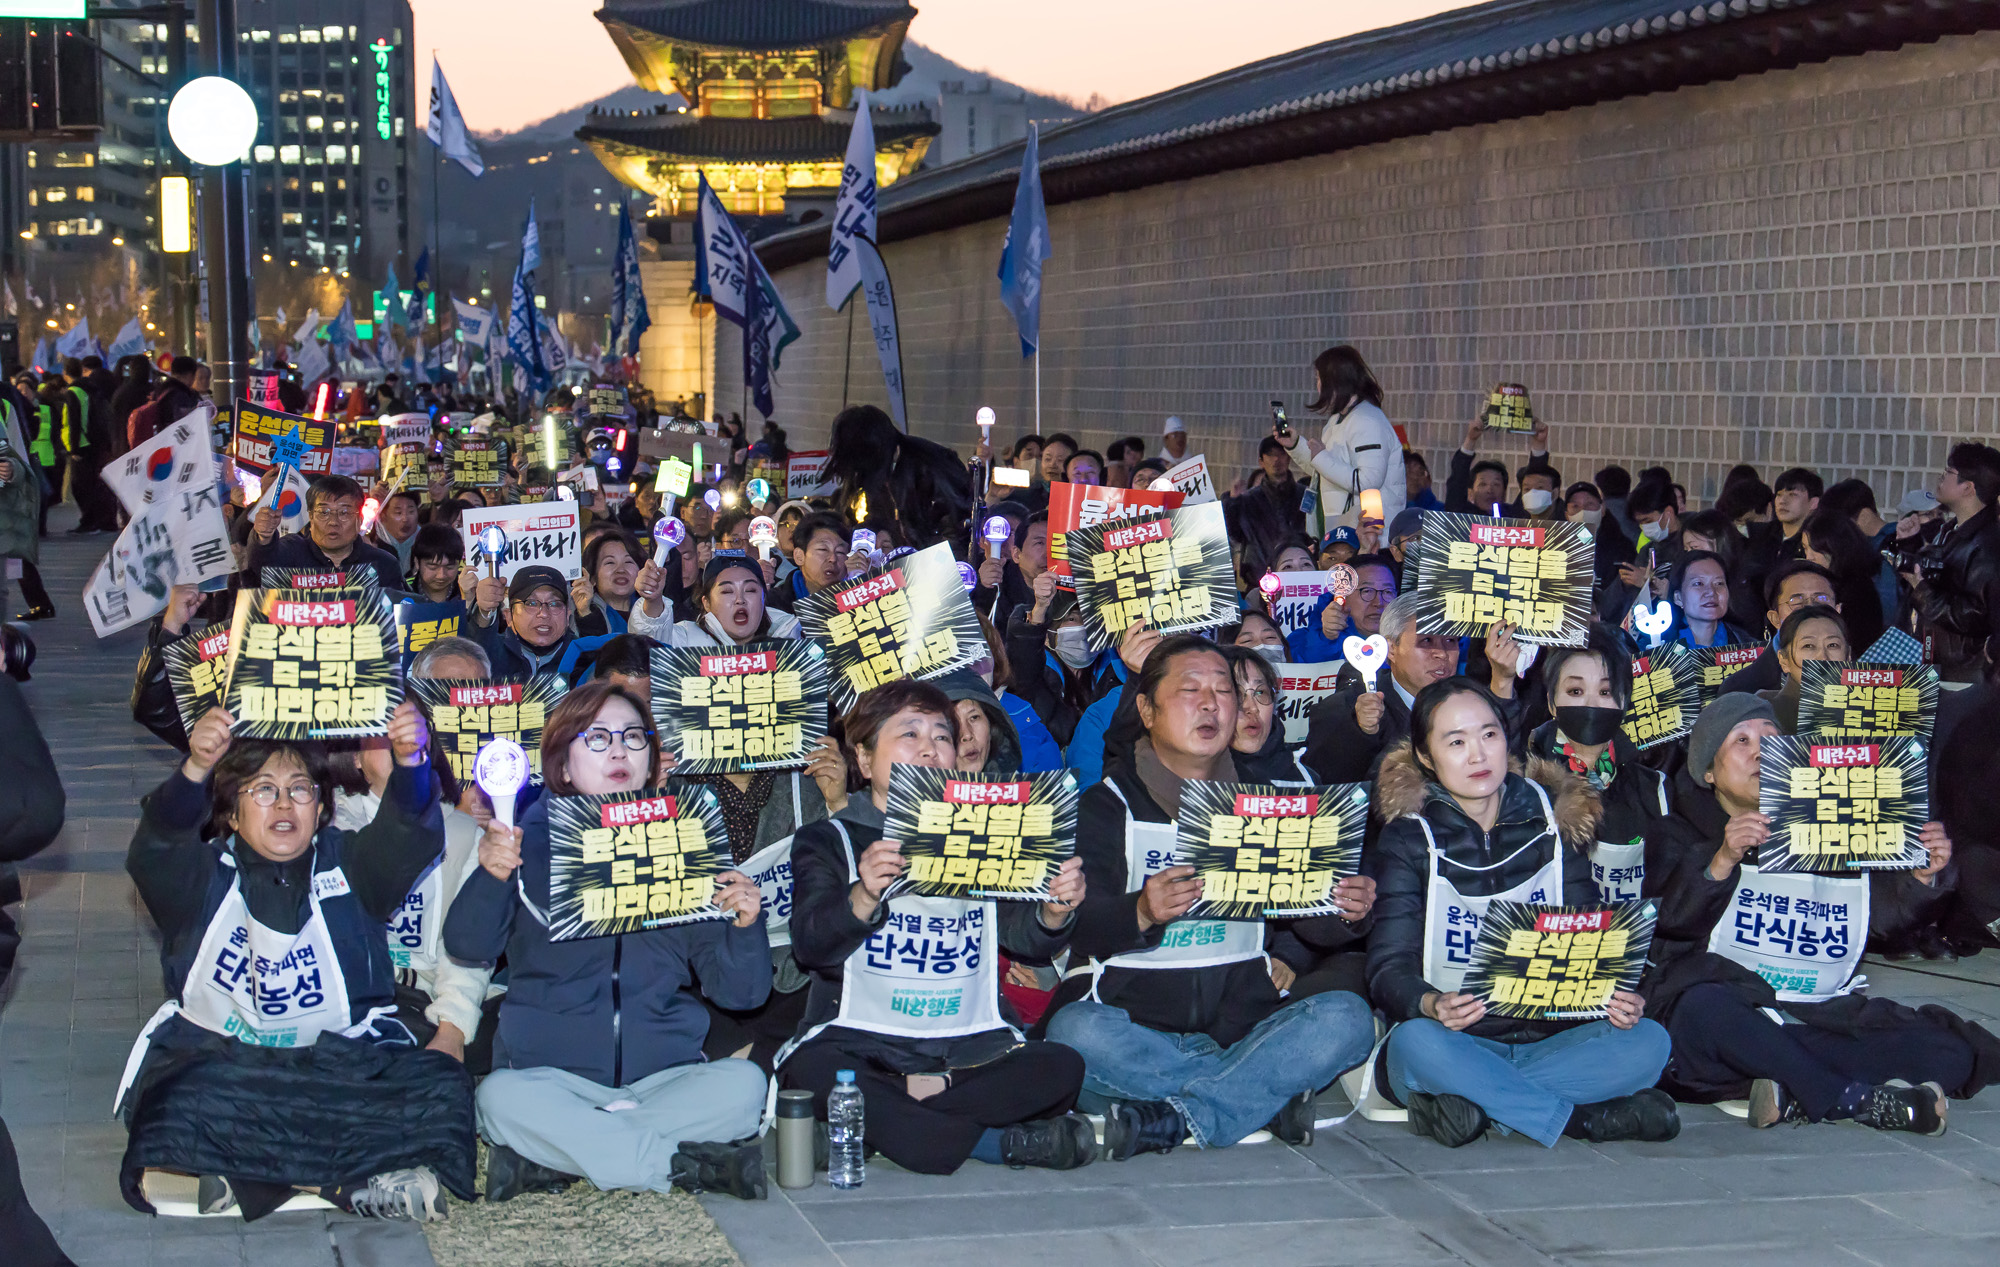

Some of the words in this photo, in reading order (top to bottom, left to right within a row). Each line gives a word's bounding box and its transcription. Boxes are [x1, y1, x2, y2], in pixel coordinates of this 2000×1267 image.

[239, 410, 325, 446] 윤석열을
[1109, 521, 1163, 546] 내란수괴
[1477, 527, 1535, 544] 내란수괴
[1091, 536, 1203, 583] 윤석열을
[1448, 541, 1568, 580] 윤석열을
[297, 575, 339, 588] 내란수괴
[841, 574, 896, 607] 내란수괴
[1115, 568, 1181, 600] 즉-각!
[1472, 572, 1540, 601] 즉-각!
[277, 602, 346, 624] 내란수괴
[1100, 585, 1212, 633] 파면하라
[1444, 592, 1565, 631] 파면하라
[246, 623, 384, 662] 윤석열을
[1720, 649, 1758, 664] 내란수괴
[272, 660, 356, 687] 즉-각!
[708, 657, 767, 675] 내란수괴
[845, 627, 960, 694] 파면하라
[680, 671, 802, 706] 윤석열을
[1847, 671, 1894, 684] 내란수괴
[239, 686, 388, 723] 파면하라
[457, 686, 513, 704] 내란수괴
[1823, 684, 1920, 712] 윤석열을
[433, 702, 545, 733] 윤석열을
[708, 703, 777, 727] 즉-각!
[1844, 709, 1899, 729] 즉-각!
[682, 723, 803, 760] 파면하라
[1816, 749, 1870, 764] 내란수괴
[953, 784, 1019, 801] 내란수괴
[1790, 767, 1903, 798] 윤석열을
[608, 798, 669, 823] 내란수괴
[917, 801, 1054, 836] 윤석열을
[1242, 797, 1308, 814] 내란수괴
[1816, 799, 1880, 822] 즉-각!
[582, 817, 708, 864] 윤석열을
[1208, 814, 1341, 848] 윤석열을
[1789, 823, 1906, 855] 파면하라
[943, 835, 1023, 859] 즉-각!
[1235, 848, 1311, 871] 즉-각!
[611, 853, 686, 884] 즉-각!
[907, 855, 1047, 887] 파면하라
[582, 876, 715, 922] 파면하라
[1202, 870, 1333, 902] 파면하라
[1737, 888, 1790, 915] 윤석열
[1794, 898, 1848, 922] 즉각파면
[887, 912, 922, 934] 석열
[1543, 914, 1602, 930] 내란수괴
[1734, 910, 1849, 958] 단식농성
[865, 933, 981, 974] 단식농성
[1505, 929, 1630, 960] 윤석열을
[1526, 959, 1599, 980] 즉-각!
[890, 995, 962, 1017] 비상행동
[1488, 976, 1617, 1007] 파면하라
